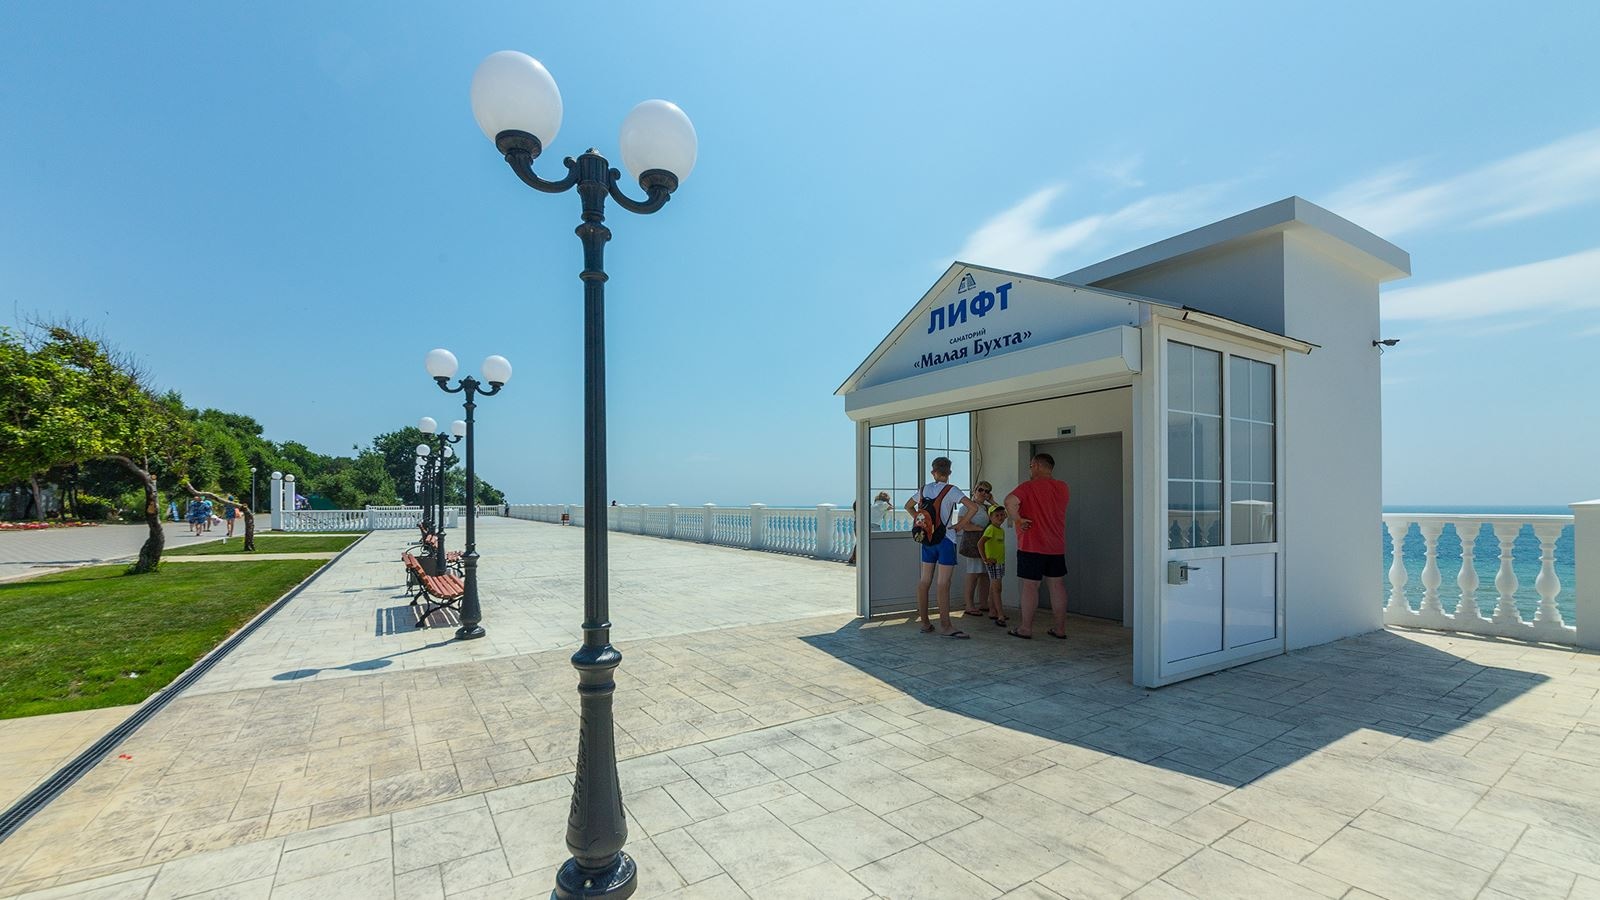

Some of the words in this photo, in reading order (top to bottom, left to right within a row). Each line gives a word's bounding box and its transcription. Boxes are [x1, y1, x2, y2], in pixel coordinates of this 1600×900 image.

[928, 282, 1012, 334] ЛИФТ
[914, 347, 968, 368] «Малая
[974, 331, 1031, 356] Бухта»
[949, 328, 986, 344] САНАТОРИЙ
